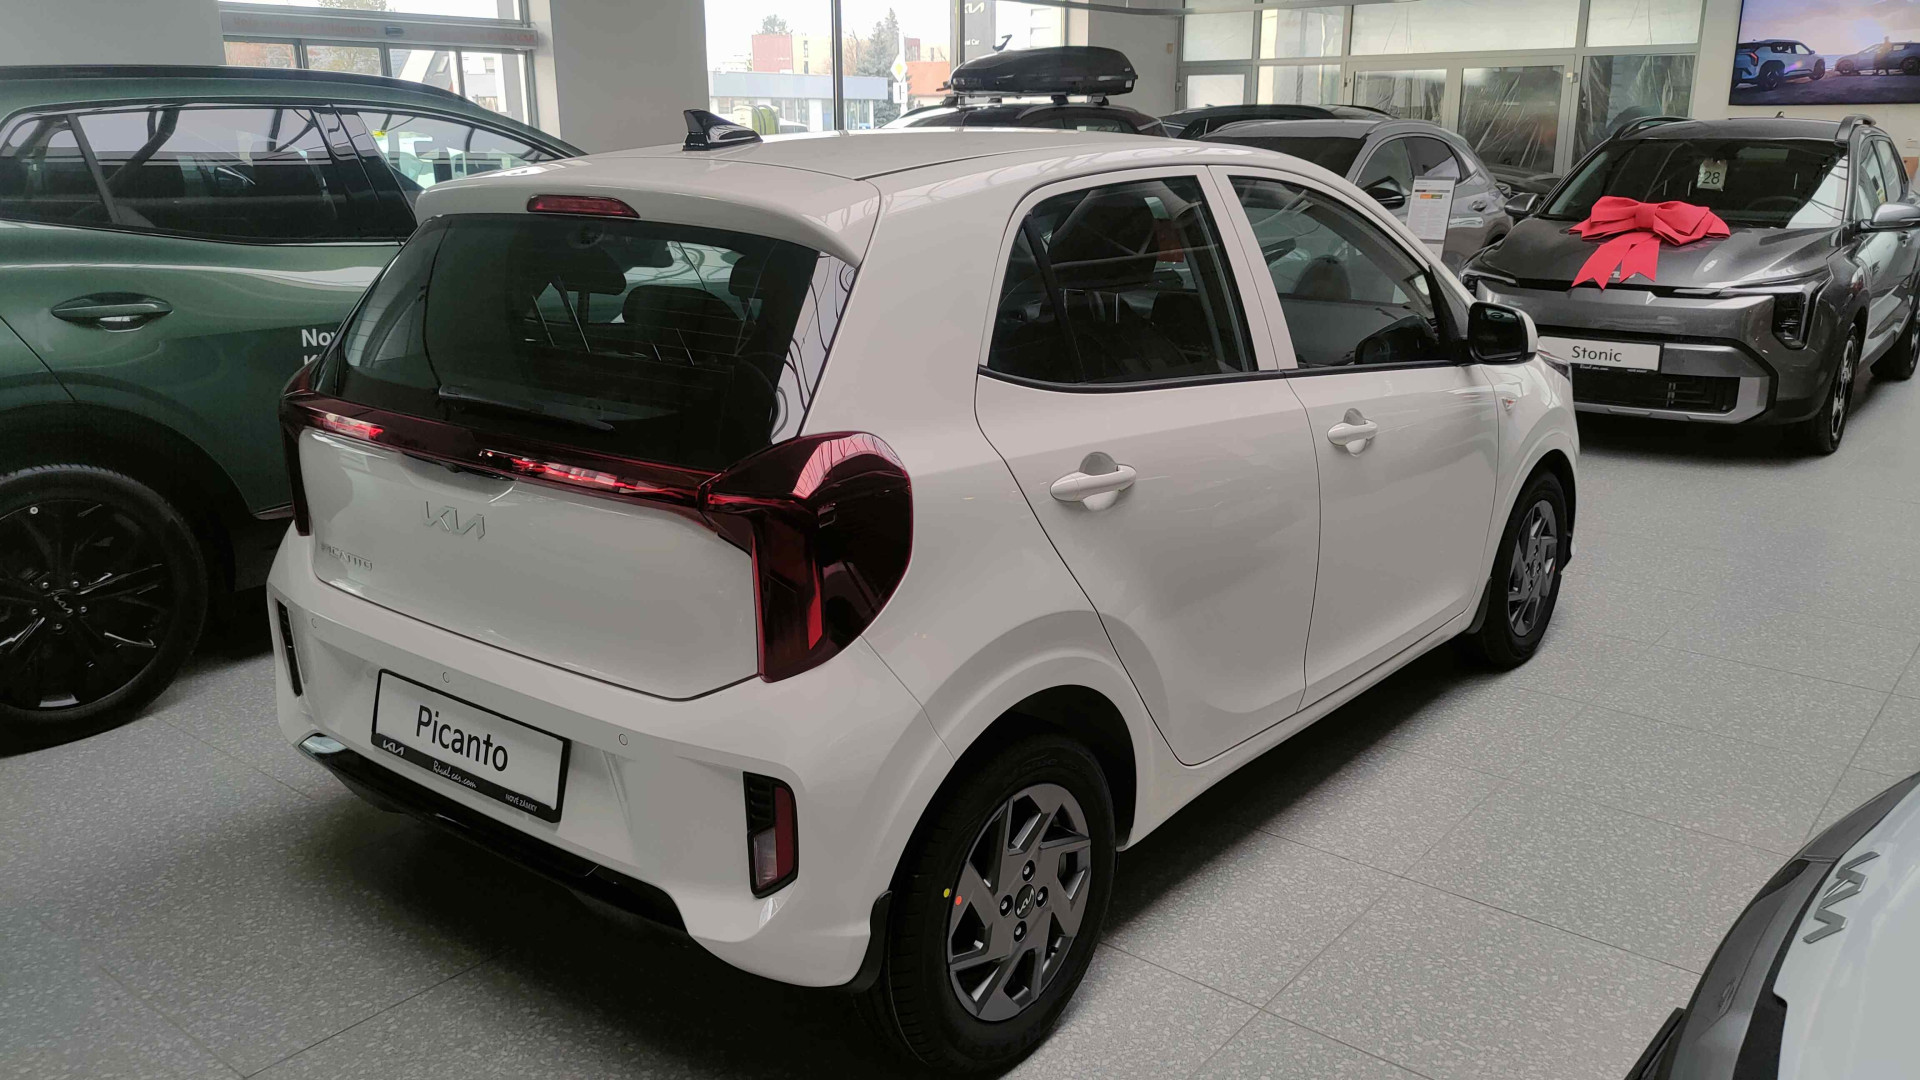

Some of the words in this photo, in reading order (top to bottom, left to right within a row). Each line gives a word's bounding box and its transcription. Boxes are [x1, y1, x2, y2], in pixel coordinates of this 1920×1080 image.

[1702, 170, 1721, 184] 28
[1571, 345, 1623, 362] Stonic
[423, 500, 486, 540] KIA
[382, 739, 405, 757] KIA
[416, 704, 508, 772] Picanto
[1016, 888, 1035, 916] KIA
[1802, 851, 1880, 944] KIA
